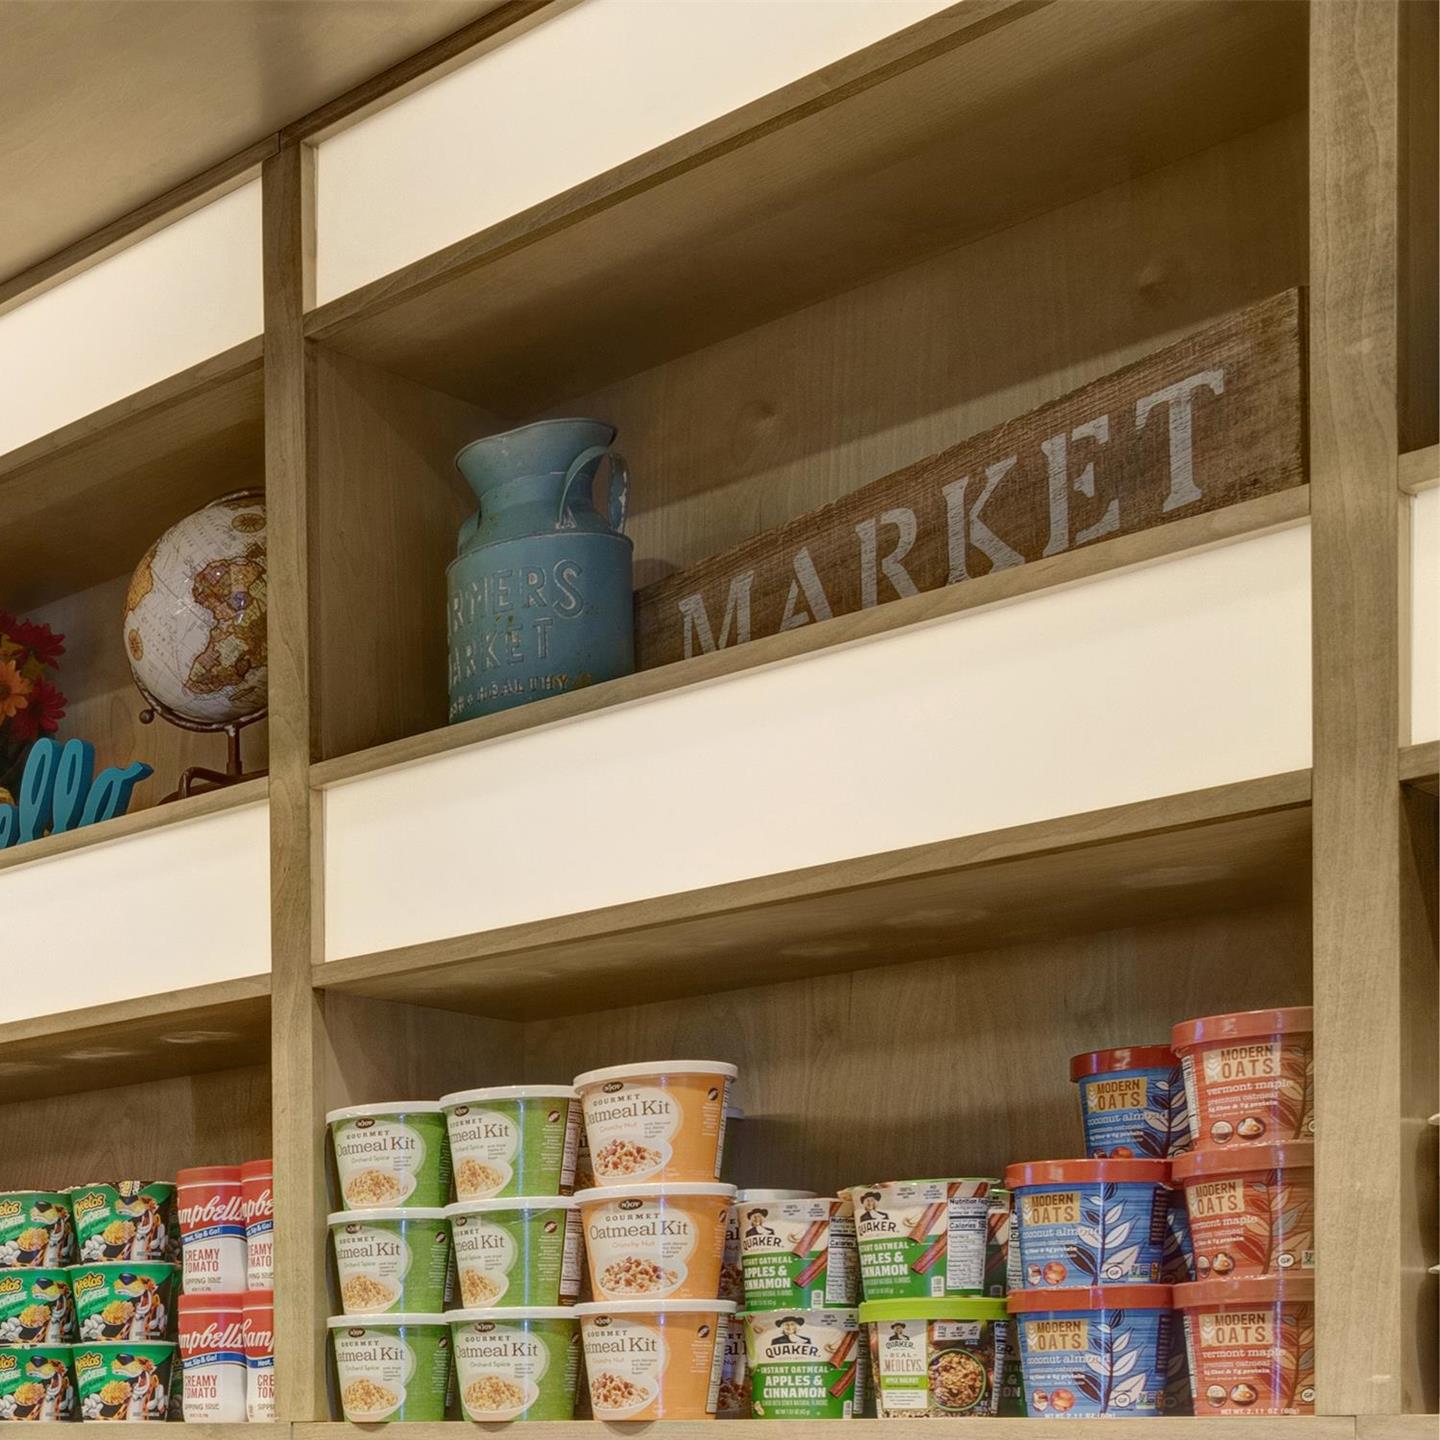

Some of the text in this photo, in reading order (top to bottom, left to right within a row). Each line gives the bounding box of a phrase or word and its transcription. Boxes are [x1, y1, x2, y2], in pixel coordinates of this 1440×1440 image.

[677, 368, 1224, 662] MARKET
[1221, 1045, 1274, 1061] MODERN
[1222, 1058, 1274, 1079] OATS
[1097, 1079, 1141, 1094] MODERN
[592, 1093, 640, 1107] GOURMET
[642, 1099, 671, 1116] Kit
[1098, 1092, 1141, 1111] OATS
[346, 1129, 390, 1140] GOURMET
[485, 1122, 510, 1138] Kit
[337, 1135, 416, 1158] Oatmeal Kit
[1195, 1182, 1237, 1198] MODERN
[1031, 1193, 1074, 1206] MODERN
[1197, 1196, 1238, 1215] OATS
[605, 1213, 660, 1222] GOURMET
[1032, 1207, 1075, 1223] OATS
[589, 1219, 689, 1240] Oatmeal Kit
[858, 1220, 897, 1237] QUAKER
[376, 1241, 401, 1257] Kit
[742, 1236, 782, 1251] QUAKER
[893, 1251, 904, 1263] &
[777, 1266, 787, 1277] &
[456, 1342, 510, 1360] Oatmeal
[765, 1344, 819, 1358] QUAKER
[885, 1340, 915, 1348] QUAKER
[760, 1365, 829, 1374] INSTANT OATMEAL
[883, 1359, 922, 1372] MEDLEYS
[765, 1375, 823, 1386] APPLES &
[763, 1386, 827, 1398] CINNAMON
